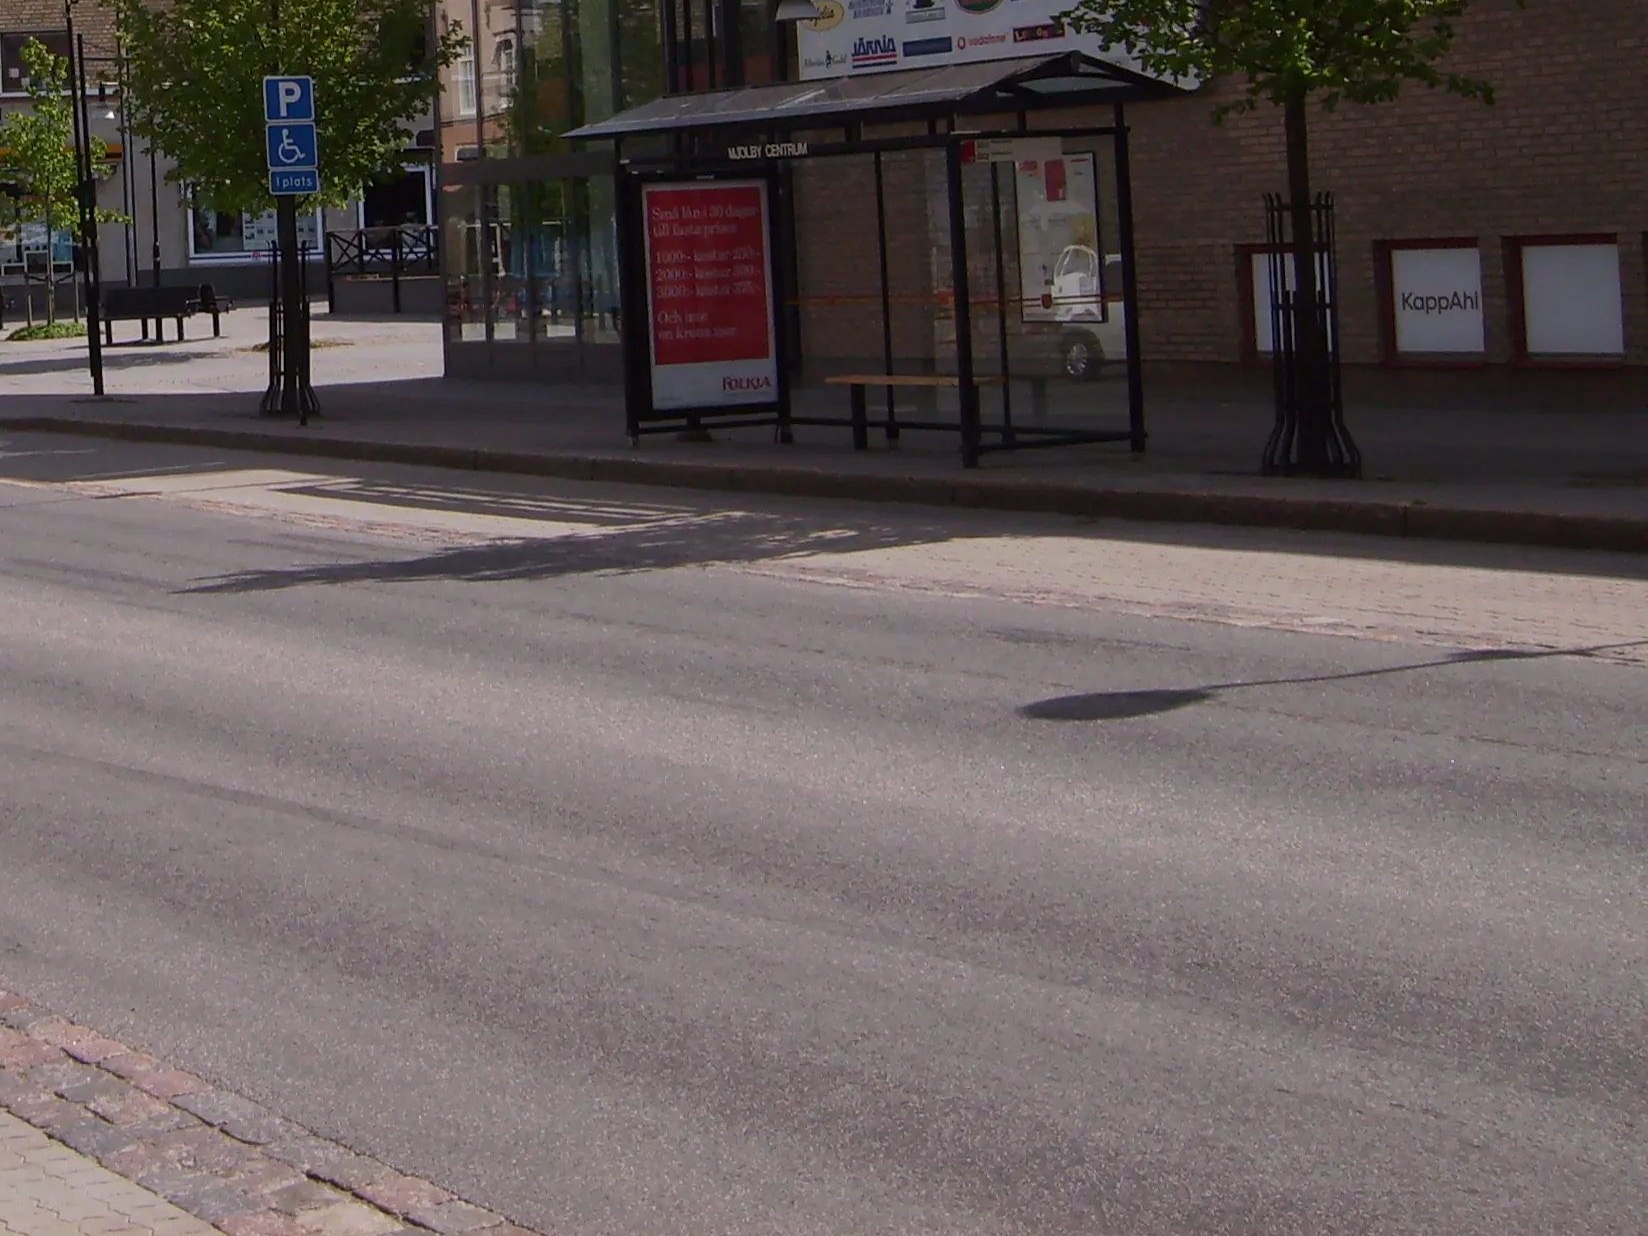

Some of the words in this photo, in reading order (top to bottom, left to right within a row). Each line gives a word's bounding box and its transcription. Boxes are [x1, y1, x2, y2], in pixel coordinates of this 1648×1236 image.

[968, 32, 1007, 47] vodafone
[278, 81, 301, 117] P
[765, 141, 808, 158] CENTRUM
[282, 176, 312, 189] plats
[1401, 291, 1479, 314] KappAhl
